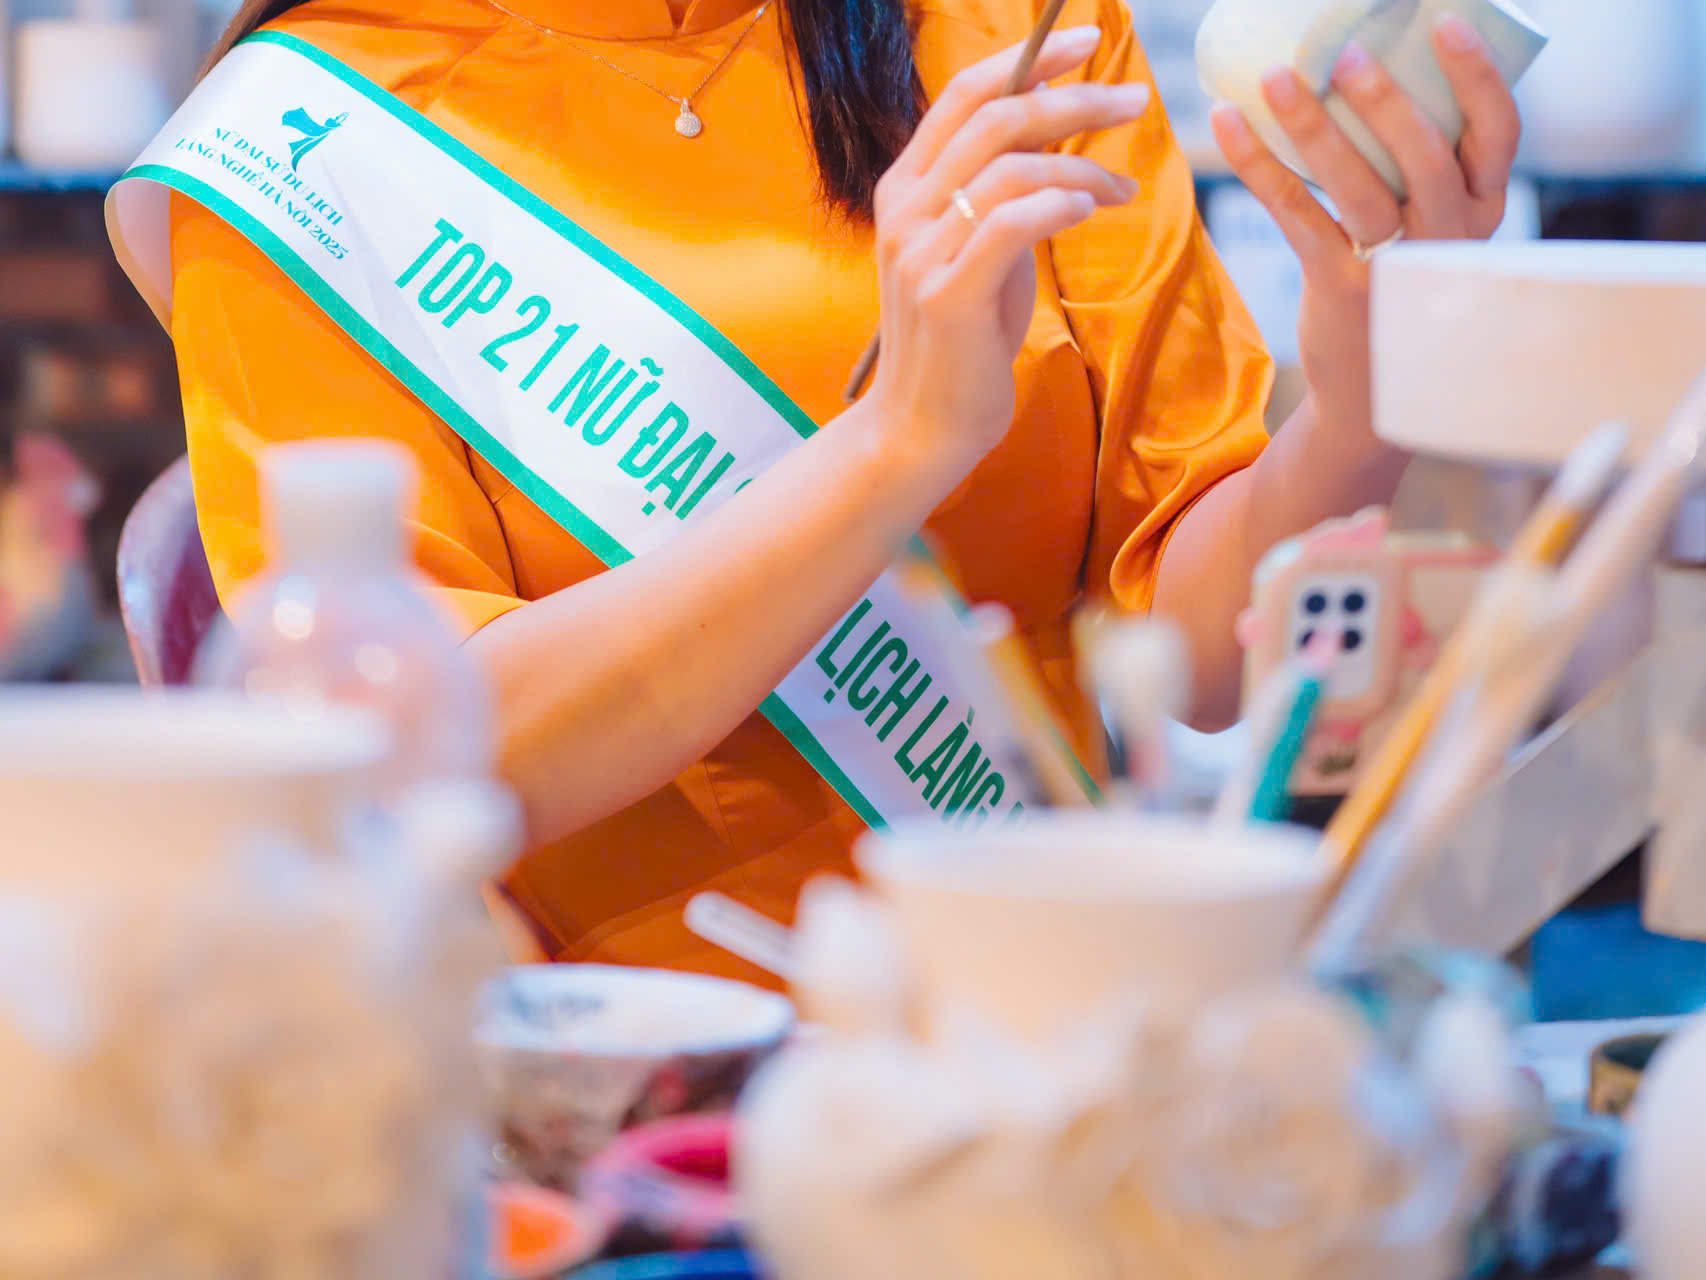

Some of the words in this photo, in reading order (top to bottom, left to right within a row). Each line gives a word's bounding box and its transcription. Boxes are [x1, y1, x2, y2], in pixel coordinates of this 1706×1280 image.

[283, 173, 310, 193] DU
[305, 191, 343, 226] LỊCH
[308, 224, 349, 259] 2025
[394, 218, 513, 328] TOP
[479, 295, 580, 391] 21
[547, 343, 664, 447] NỮ
[617, 401, 736, 521] ĐẠI
[815, 598, 933, 743] LỊCH
